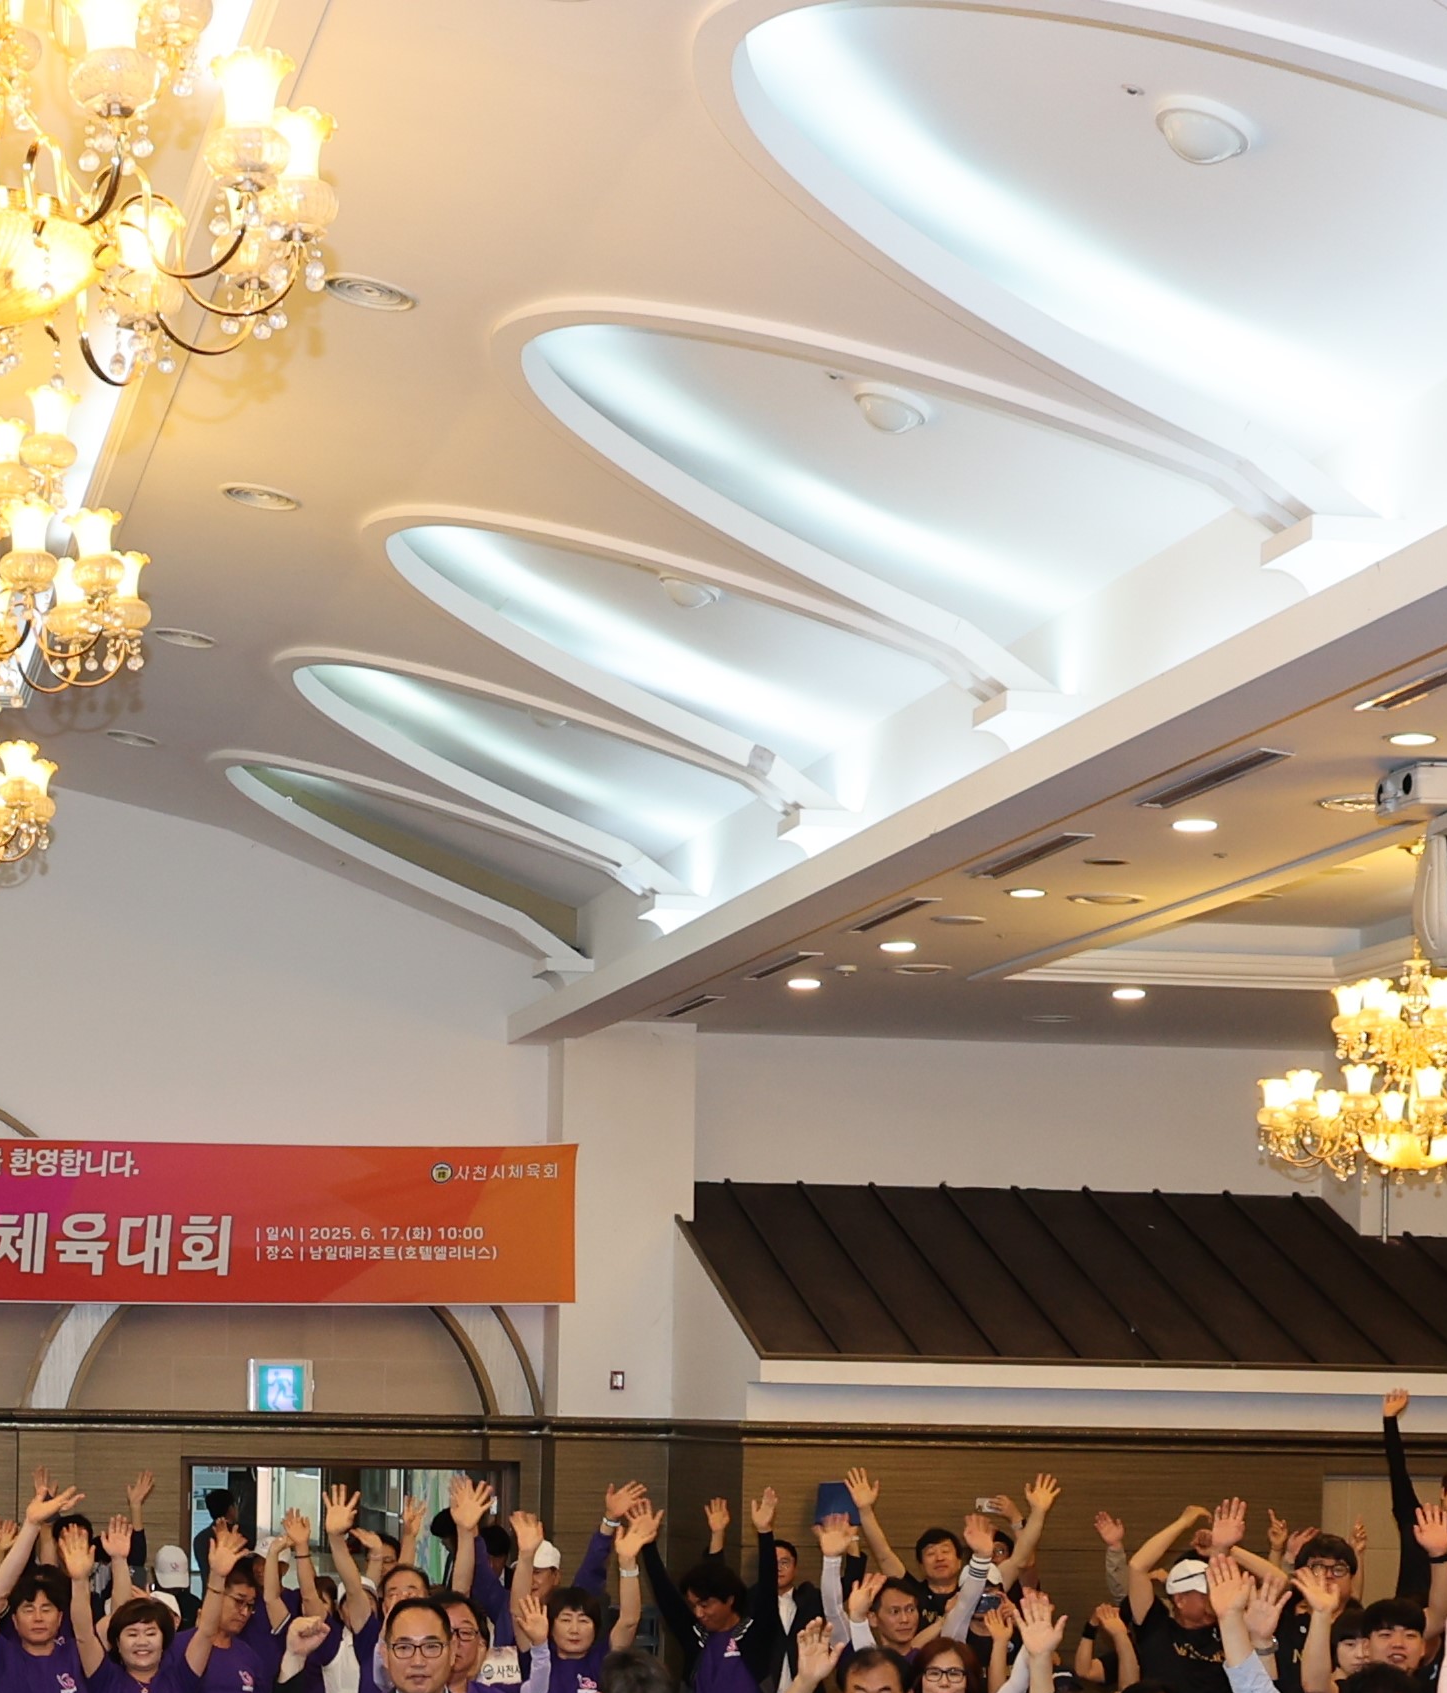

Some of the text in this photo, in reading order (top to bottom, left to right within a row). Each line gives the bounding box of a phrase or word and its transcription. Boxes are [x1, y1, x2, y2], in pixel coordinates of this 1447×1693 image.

[9, 1148, 140, 1177] 환영합니다.
[453, 1162, 558, 1181] 사천시체육회
[266, 1227, 295, 1241] 일시
[309, 1227, 356, 1241] 2025.
[360, 1227, 375, 1241] 6.
[437, 1227, 484, 1241] 10:00
[266, 1246, 498, 1261] 장소 남일대리조트(호텔엘리너스)
